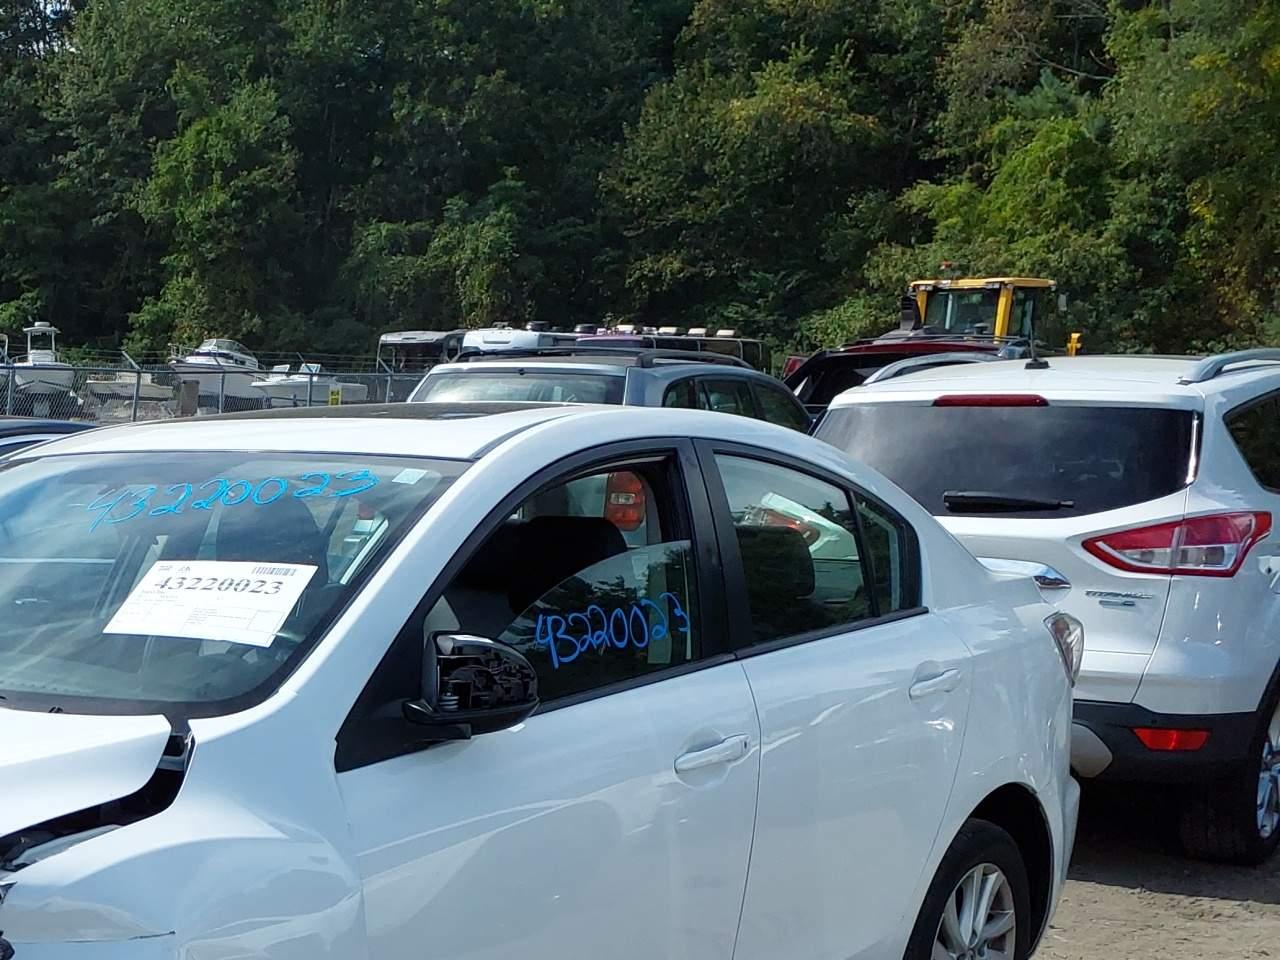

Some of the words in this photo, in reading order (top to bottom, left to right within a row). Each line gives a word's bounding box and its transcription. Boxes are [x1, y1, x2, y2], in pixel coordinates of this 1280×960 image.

[87, 469, 380, 534] 43220023
[154, 576, 284, 595] 43220023
[535, 592, 692, 670] 43220023
